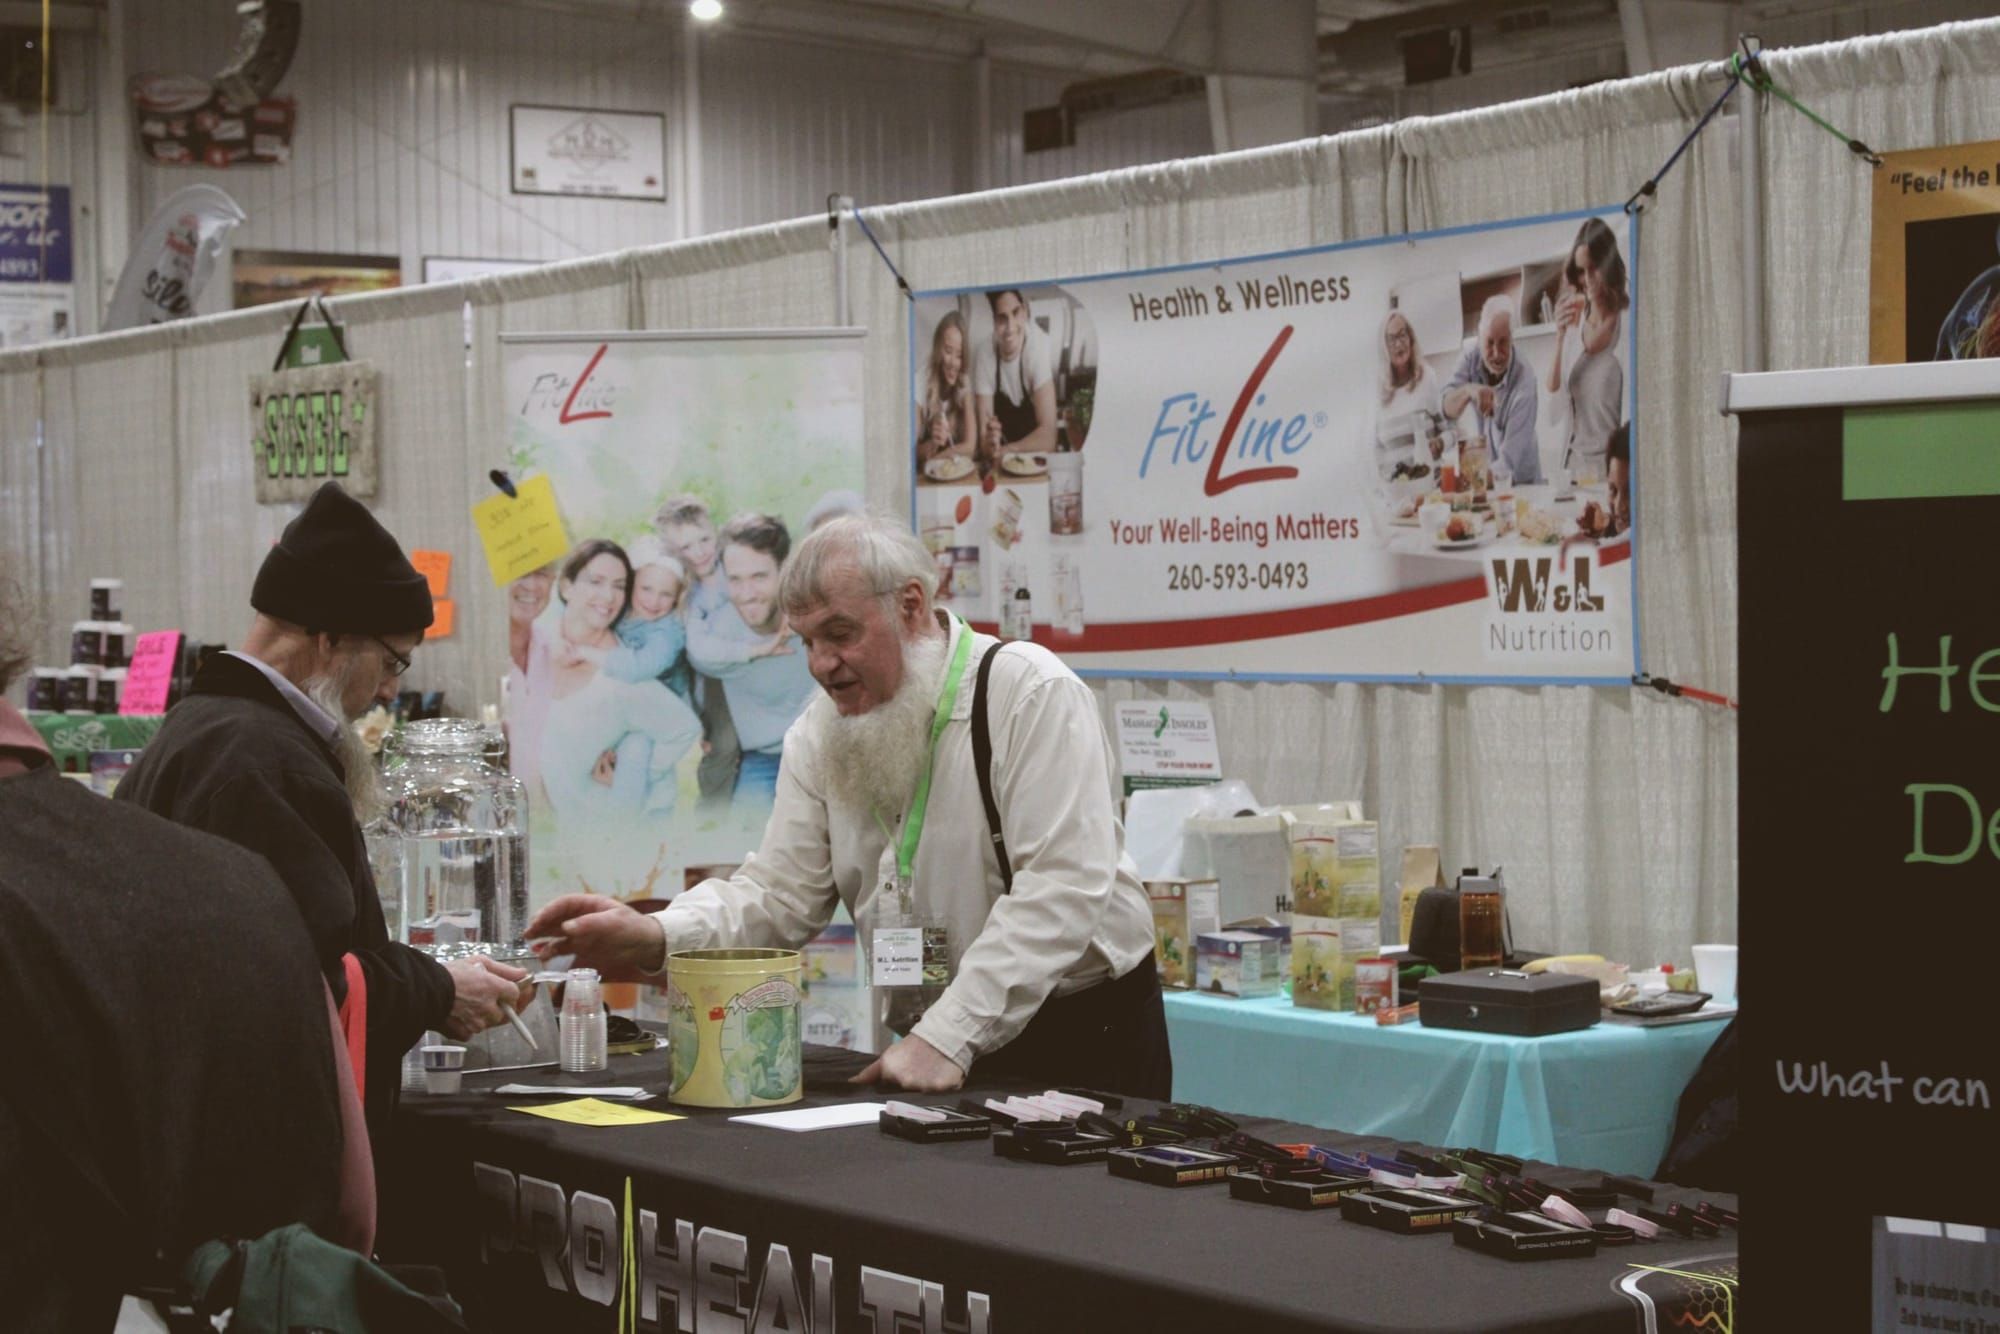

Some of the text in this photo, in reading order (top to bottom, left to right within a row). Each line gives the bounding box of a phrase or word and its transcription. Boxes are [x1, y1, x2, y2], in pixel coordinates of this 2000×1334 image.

[1953, 164, 1989, 189] the
[1129, 275, 1350, 322] Health & Wellness
[265, 390, 349, 479] SISEL
[1110, 512, 1359, 548] Your Well-Being Matters
[1167, 561, 1309, 590] 260-593-0493
[1491, 556, 1605, 613] W&L
[1489, 621, 1612, 652] Nutrition
[1776, 1060, 1991, 1110] What can
